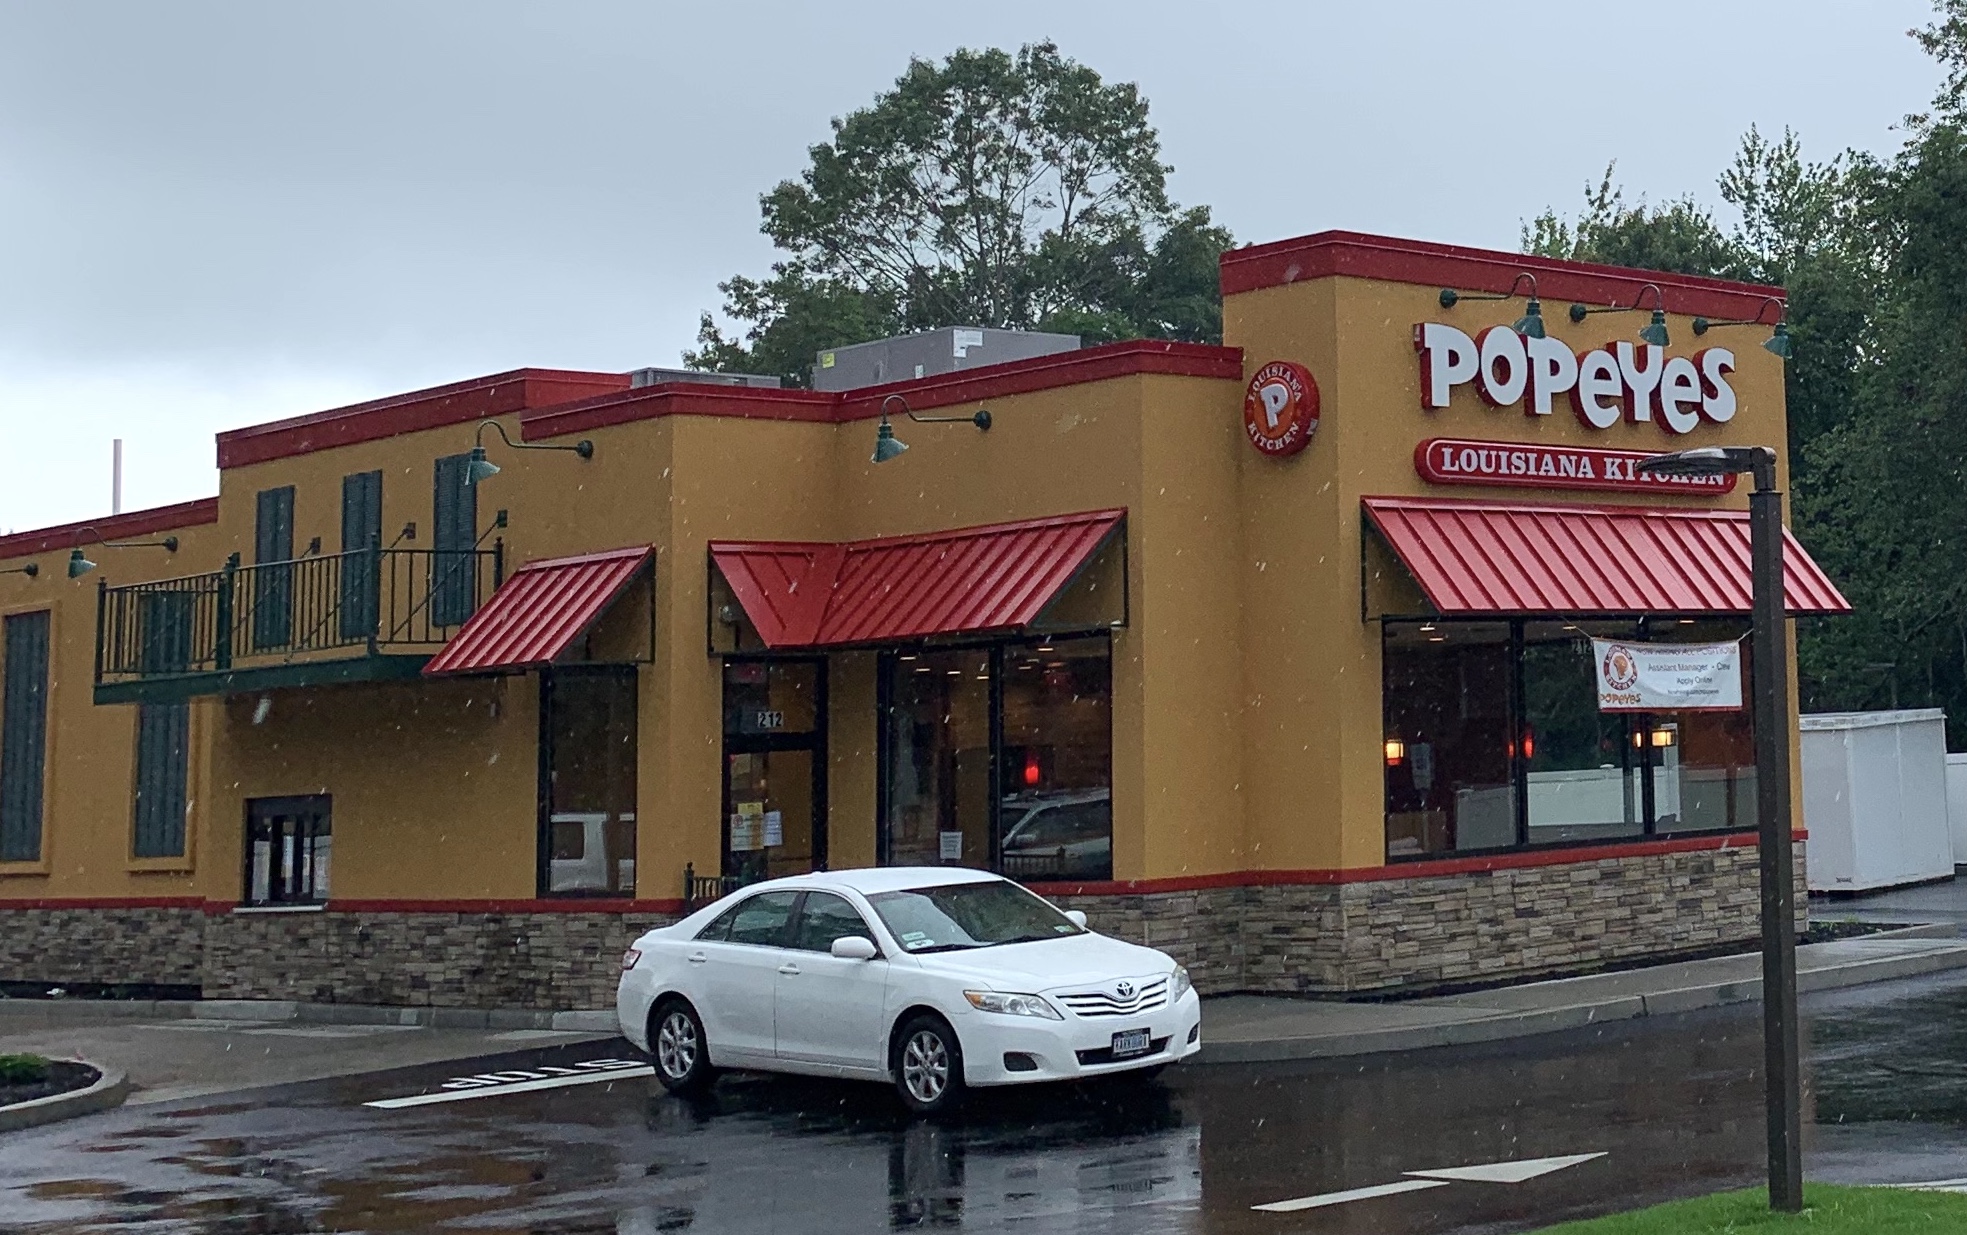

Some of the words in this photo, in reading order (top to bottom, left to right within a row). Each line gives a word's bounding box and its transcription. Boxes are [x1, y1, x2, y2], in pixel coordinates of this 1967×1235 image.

[1247, 366, 1302, 402] LOUISIANA
[1260, 383, 1289, 429] P
[1248, 422, 1299, 450] KITCHEN
[1441, 446, 1595, 479] LOUISIANA
[1678, 663, 1708, 672] Manager
[759, 712, 783, 727] 212
